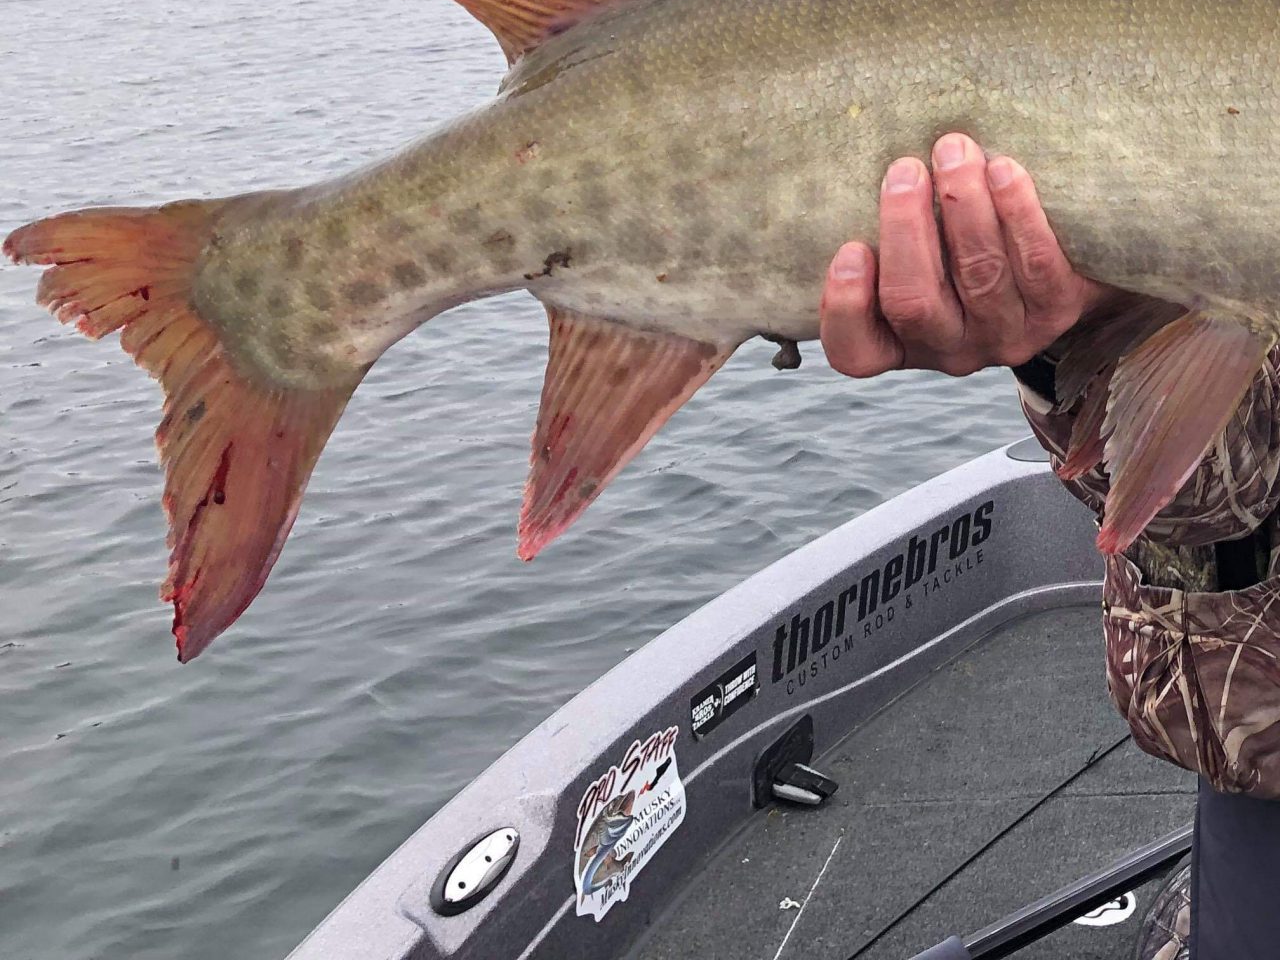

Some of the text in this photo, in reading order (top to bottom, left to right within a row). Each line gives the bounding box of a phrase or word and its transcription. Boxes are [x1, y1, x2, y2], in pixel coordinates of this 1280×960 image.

[772, 500, 994, 683] thornebros
[786, 549, 984, 695] CUSTOM ROD & TACKLE
[621, 729, 677, 792] STAFF
[616, 798, 674, 857] INNOVATIONS
[634, 787, 671, 825] MUSKY
